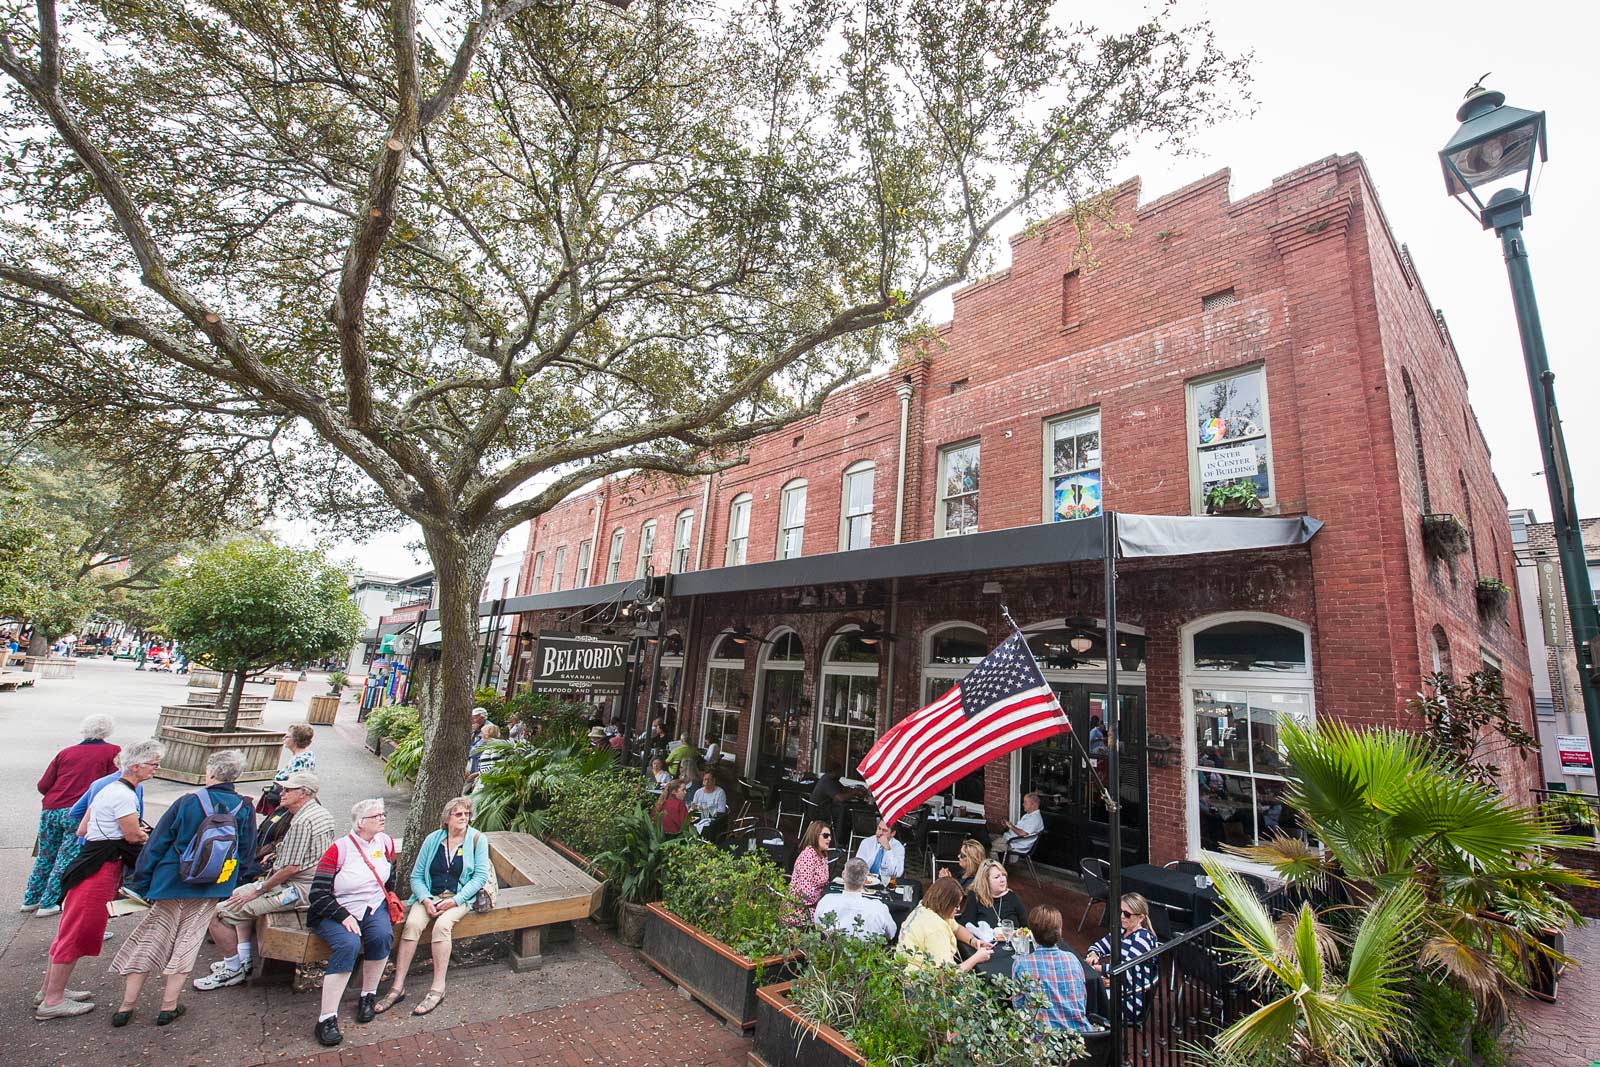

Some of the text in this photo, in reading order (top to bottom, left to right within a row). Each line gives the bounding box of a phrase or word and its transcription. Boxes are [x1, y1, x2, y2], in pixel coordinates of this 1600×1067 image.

[1215, 451, 1240, 460] ENTER
[1217, 457, 1250, 467] CENTER
[1216, 466, 1255, 475] BUILDING
[1546, 574, 1558, 643] CITY MARKET
[541, 645, 623, 676] BELFORD'S
